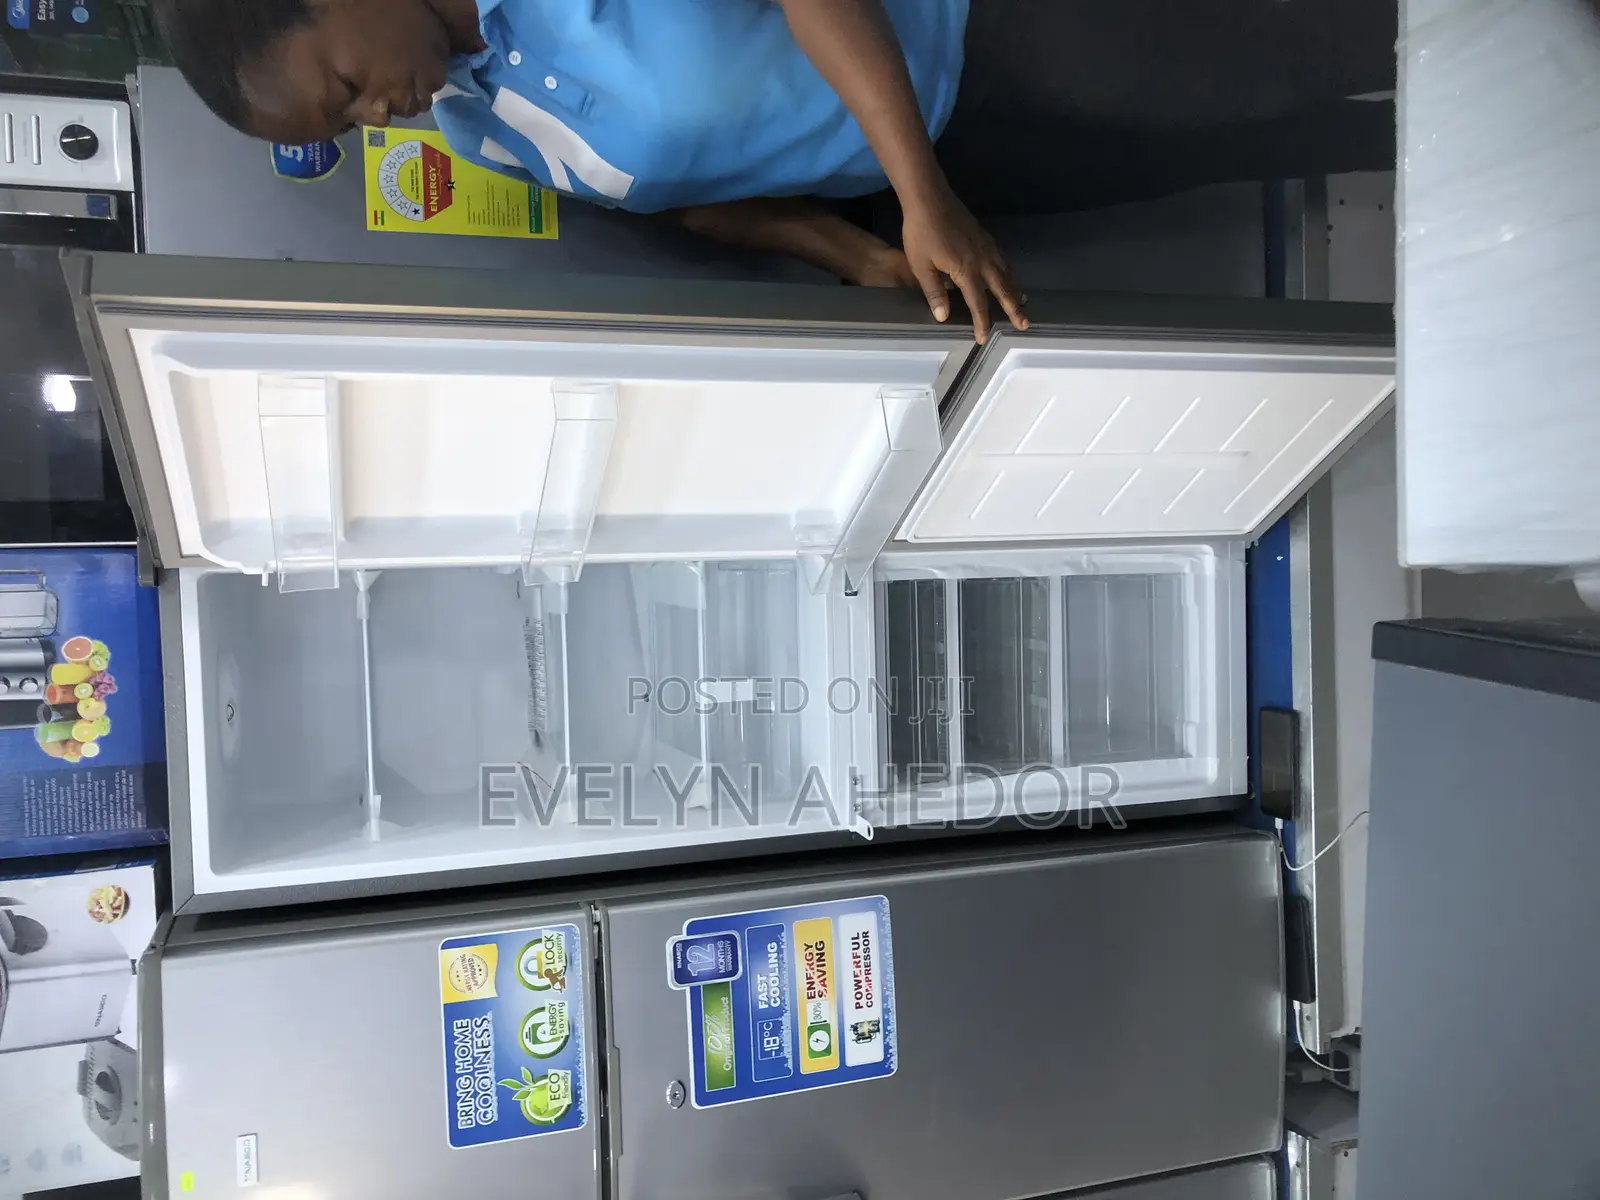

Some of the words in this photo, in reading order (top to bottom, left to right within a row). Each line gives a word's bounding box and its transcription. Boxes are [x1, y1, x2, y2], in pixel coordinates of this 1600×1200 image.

[279, 144, 304, 163] 5
[314, 141, 322, 173] WARRAN
[429, 164, 440, 213] ENERGY
[544, 935, 556, 966] LOCK
[555, 933, 564, 964] security
[686, 943, 716, 977] 12
[717, 941, 727, 974] MONTHS
[725, 940, 733, 972] WARRANTY
[467, 957, 479, 987] APPROVED
[767, 942, 781, 1009] COOLING
[804, 942, 816, 1001] ENERGY
[815, 940, 828, 999] SAVING
[851, 932, 863, 1010] POWERFUL
[861, 930, 874, 1009] COMPRESSOR
[757, 974, 768, 1010] FAST
[548, 1003, 558, 1037] ENERGY
[557, 1002, 566, 1035] saving
[720, 997, 731, 1031] Product
[453, 1019, 473, 1075] HOME
[704, 1014, 725, 1055] 100%
[719, 1033, 733, 1071] Original
[472, 1017, 495, 1126] COOLNESS
[550, 1072, 561, 1101] ECO
[561, 1071, 570, 1100] friendly
[456, 1077, 476, 1129] BRING
